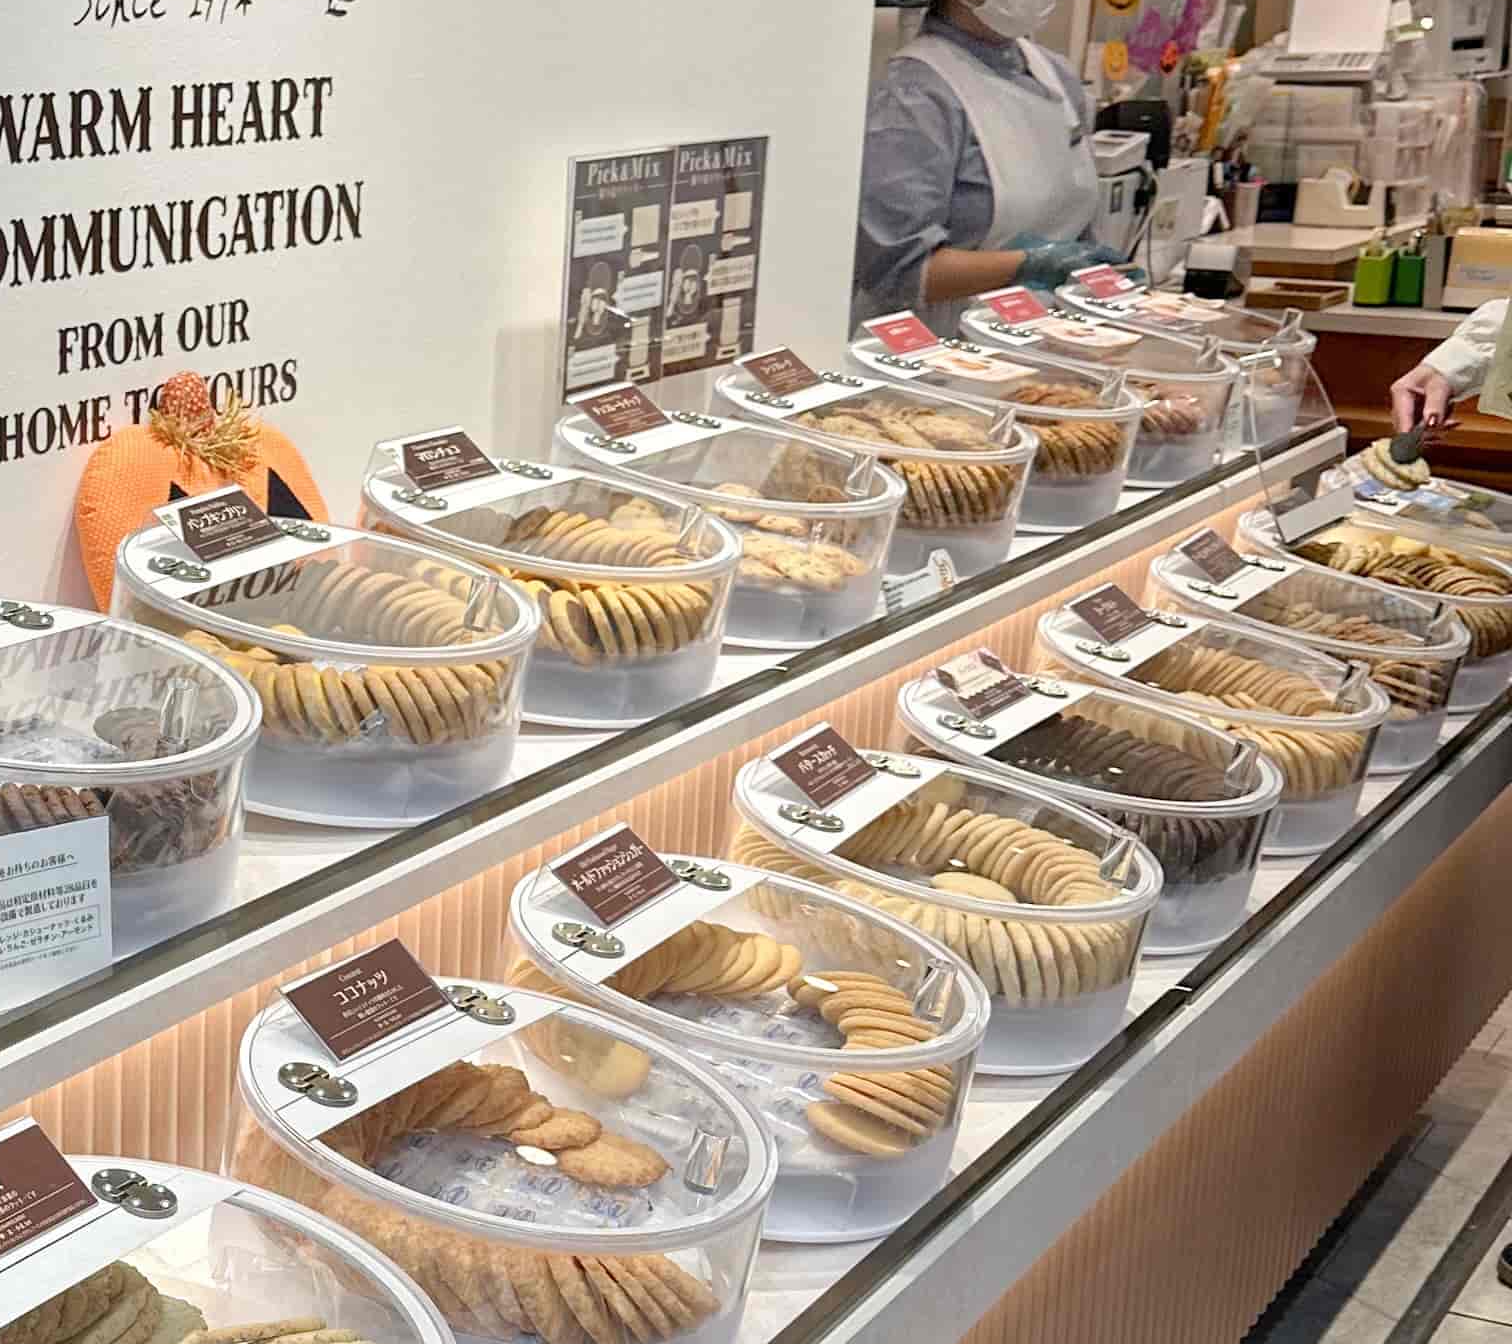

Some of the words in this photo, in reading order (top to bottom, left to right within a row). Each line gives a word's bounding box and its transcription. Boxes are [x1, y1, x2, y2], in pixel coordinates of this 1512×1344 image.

[171, 77, 333, 150] HEART
[56, 313, 163, 375] FROM
[177, 298, 249, 352] OUR
[203, 359, 297, 416] OURS
[332, 968, 389, 1006] ココナッツ
